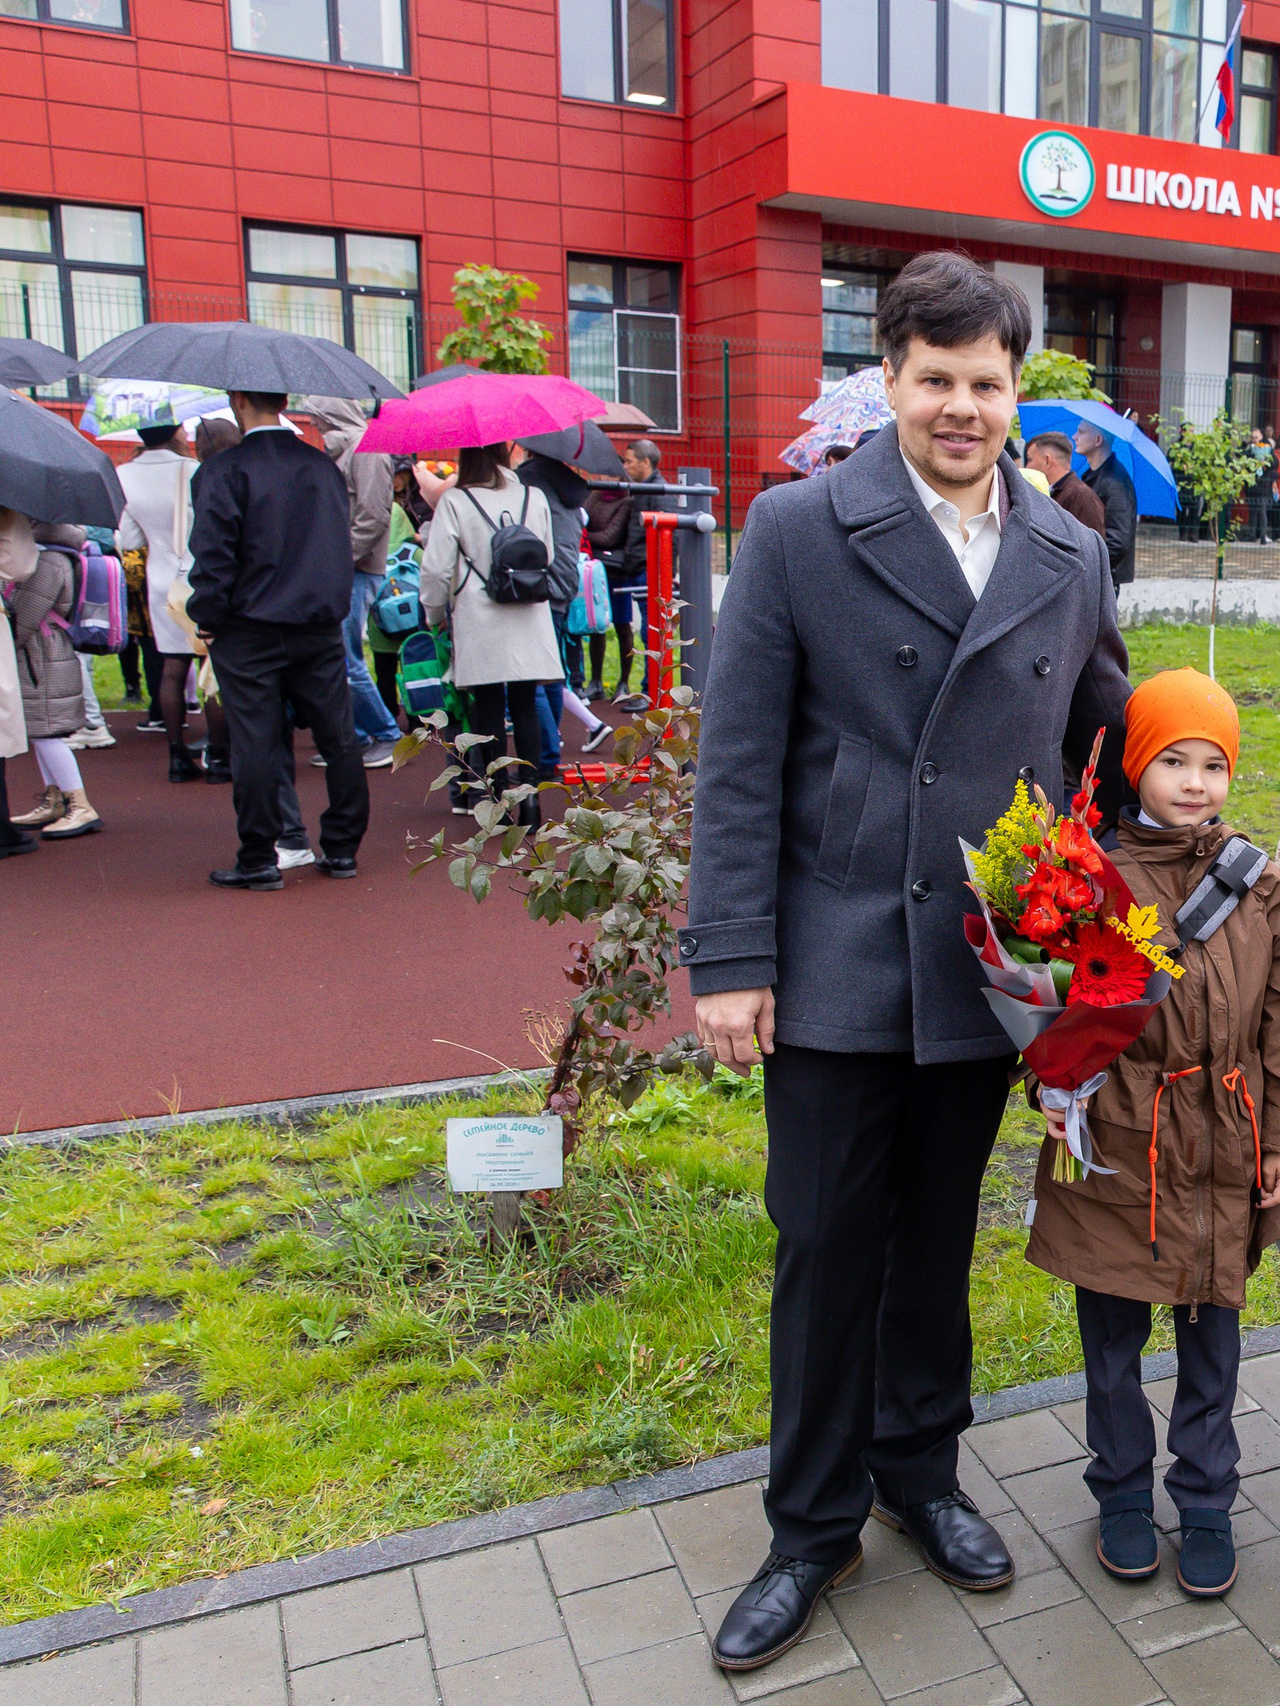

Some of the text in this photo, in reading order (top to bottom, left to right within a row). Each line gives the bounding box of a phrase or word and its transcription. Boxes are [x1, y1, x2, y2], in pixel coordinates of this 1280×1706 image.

[1106, 163, 1242, 217] ШКОЛА
[1142, 913, 1151, 927] 1
[1105, 916, 1187, 979] ентября
[463, 1122, 545, 1137] СЕМЕЙНОЕ ДЕРЕВО
